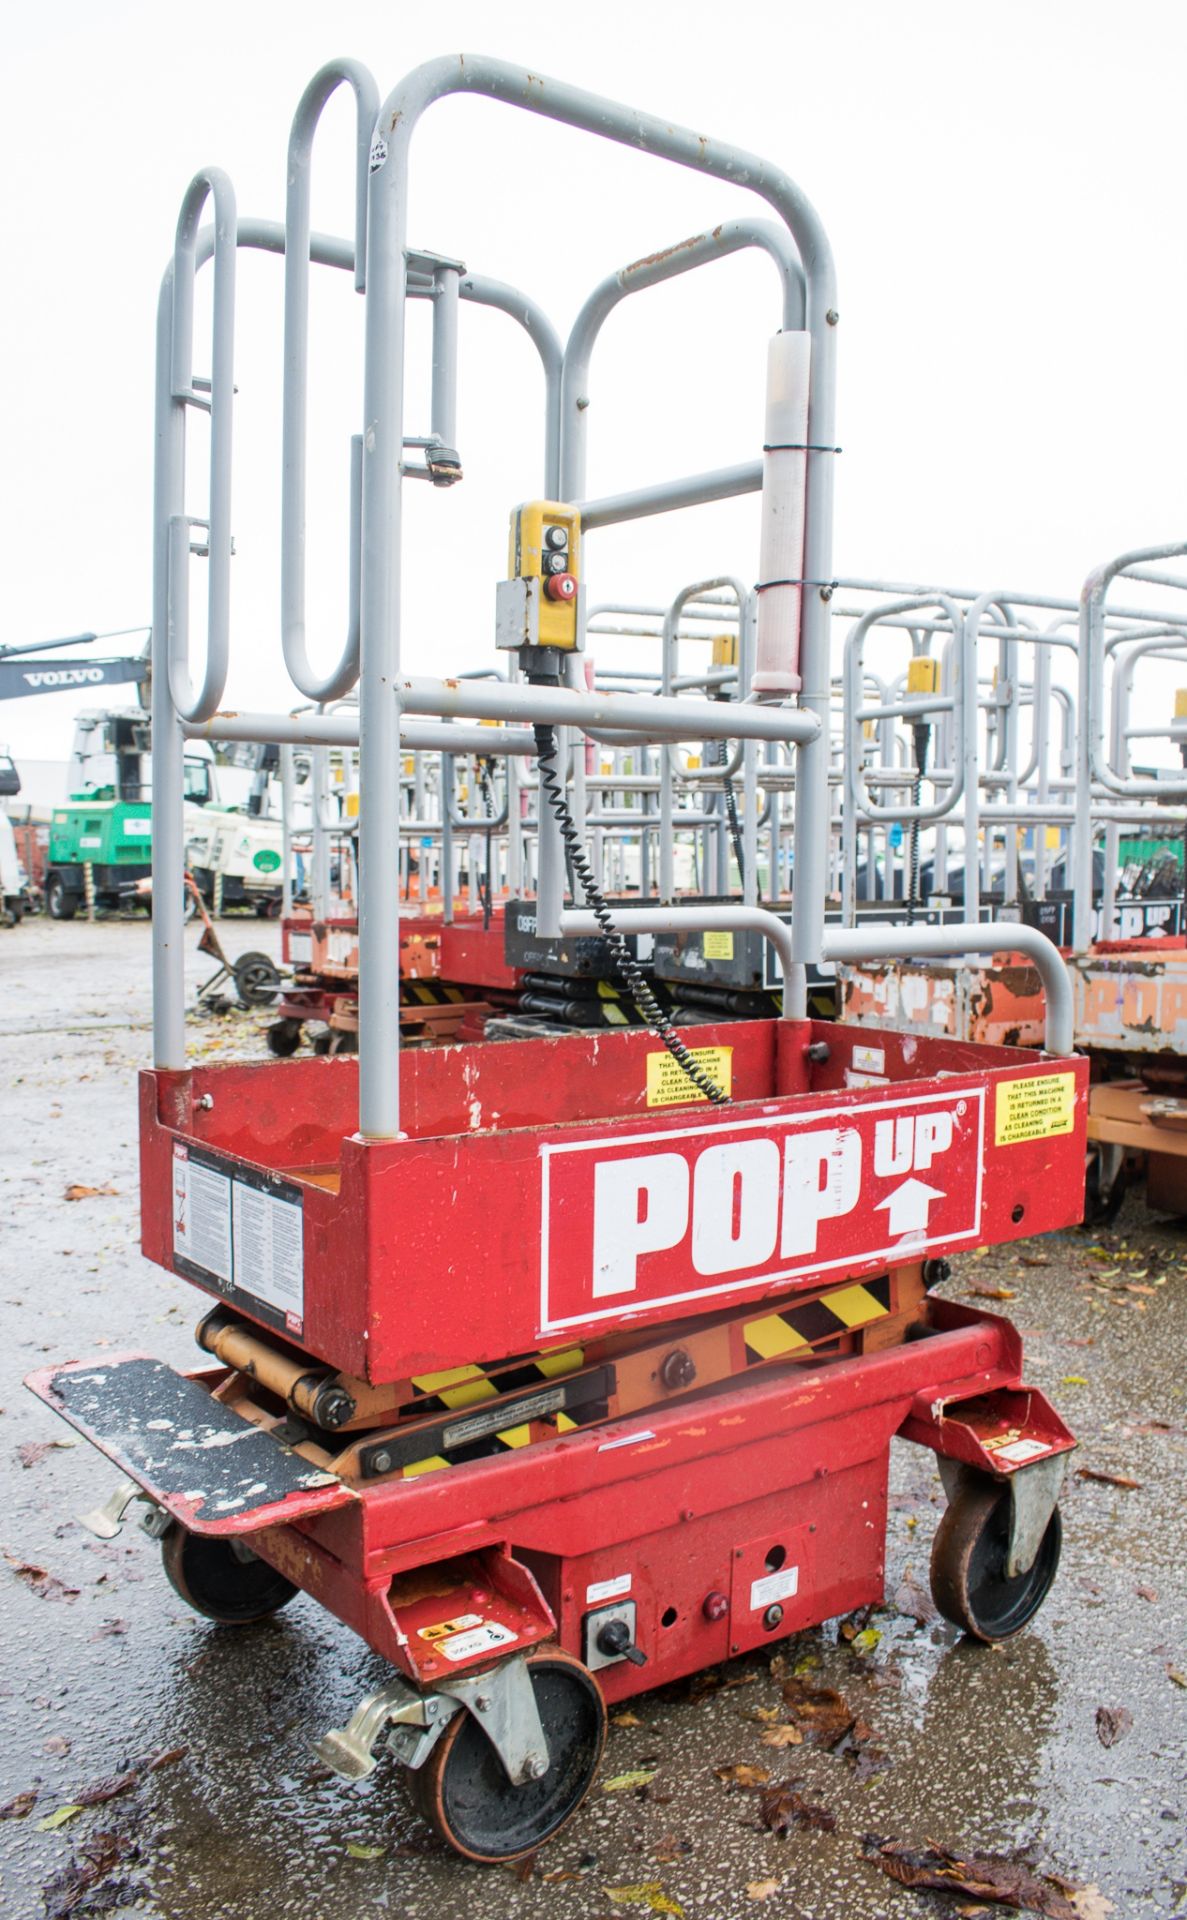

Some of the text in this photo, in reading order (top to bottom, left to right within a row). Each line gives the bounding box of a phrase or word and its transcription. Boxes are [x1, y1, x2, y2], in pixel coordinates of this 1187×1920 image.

[22, 668, 104, 687] VOLVO
[1013, 1077, 1059, 1089] PLEASE ENSURE
[1007, 1092, 1022, 1101] THAT
[1038, 1086, 1064, 1095] MACHINE
[1009, 1107, 1061, 1121] CLEAN CONDITION
[1014, 1119, 1043, 1129] CLEANING
[1008, 1128, 1046, 1140] CHARGEABLE
[592, 1111, 954, 1299] POP UP
